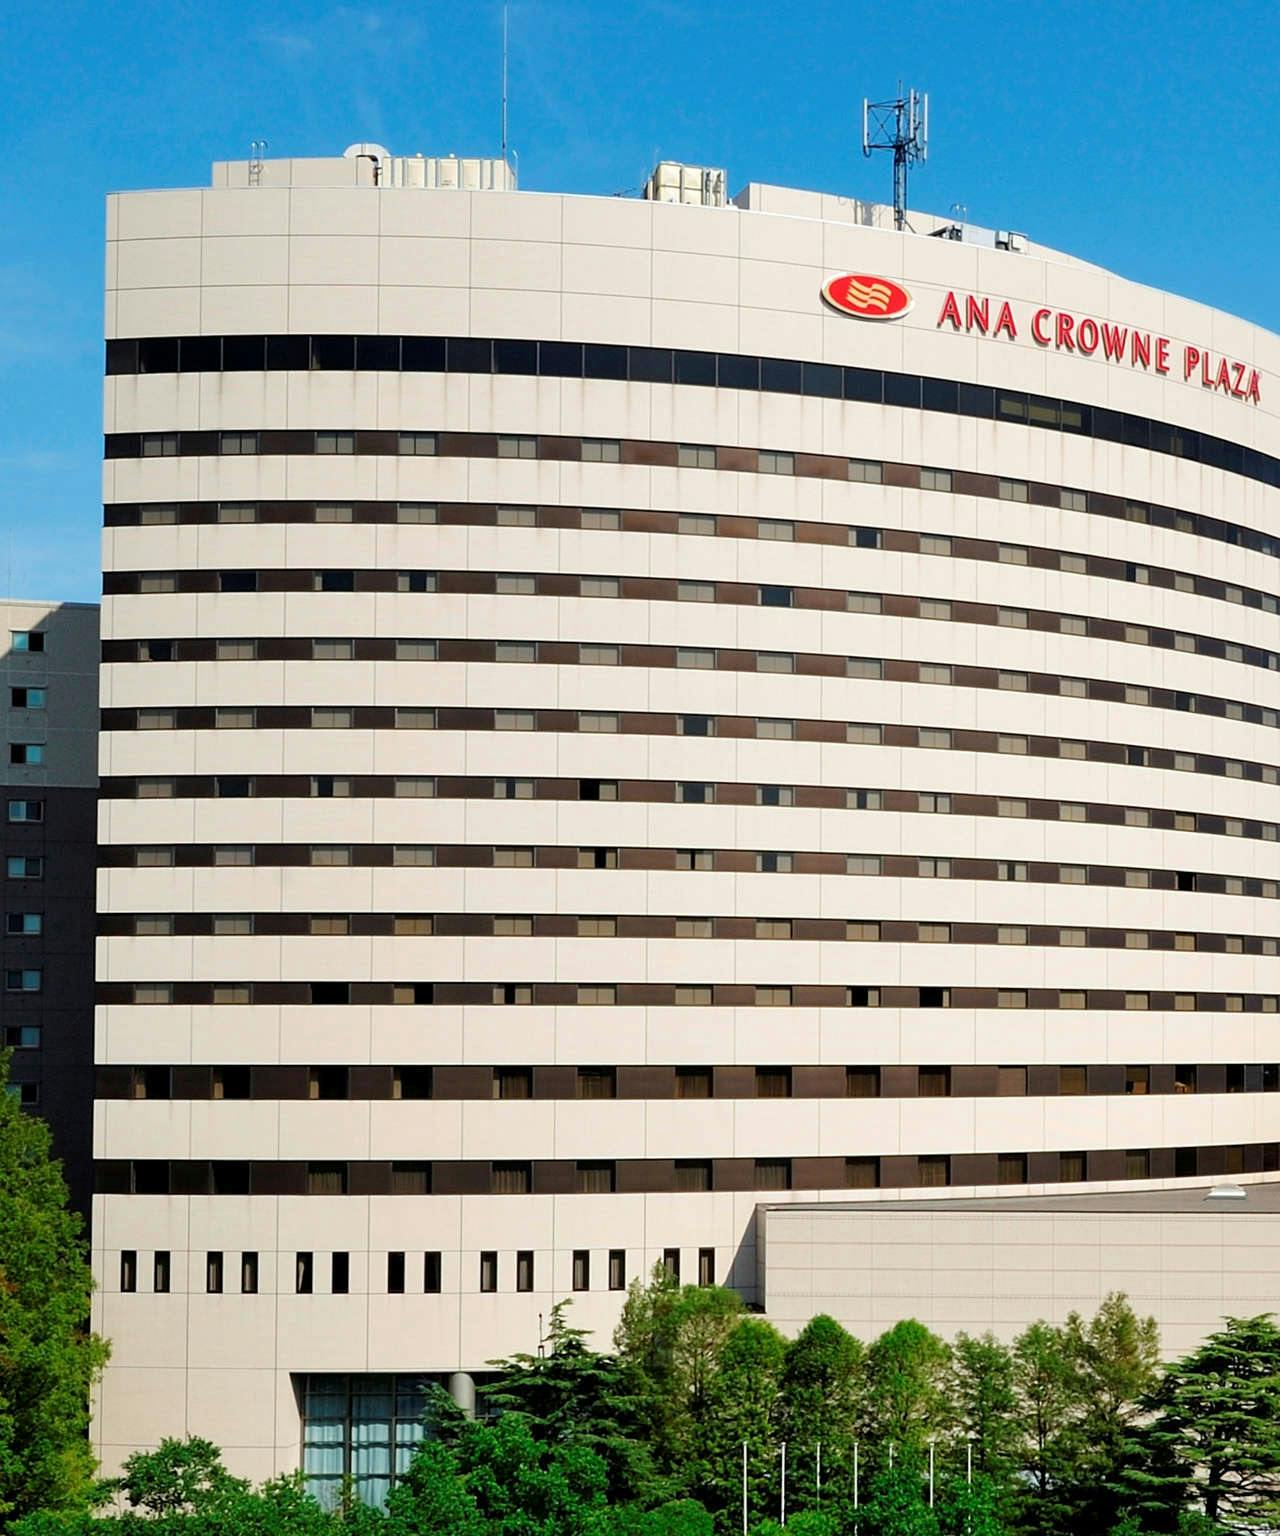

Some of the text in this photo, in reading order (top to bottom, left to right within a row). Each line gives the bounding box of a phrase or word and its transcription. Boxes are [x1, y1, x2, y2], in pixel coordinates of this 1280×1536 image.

[937, 291, 1262, 405] ANA CROWNE PLAZA
